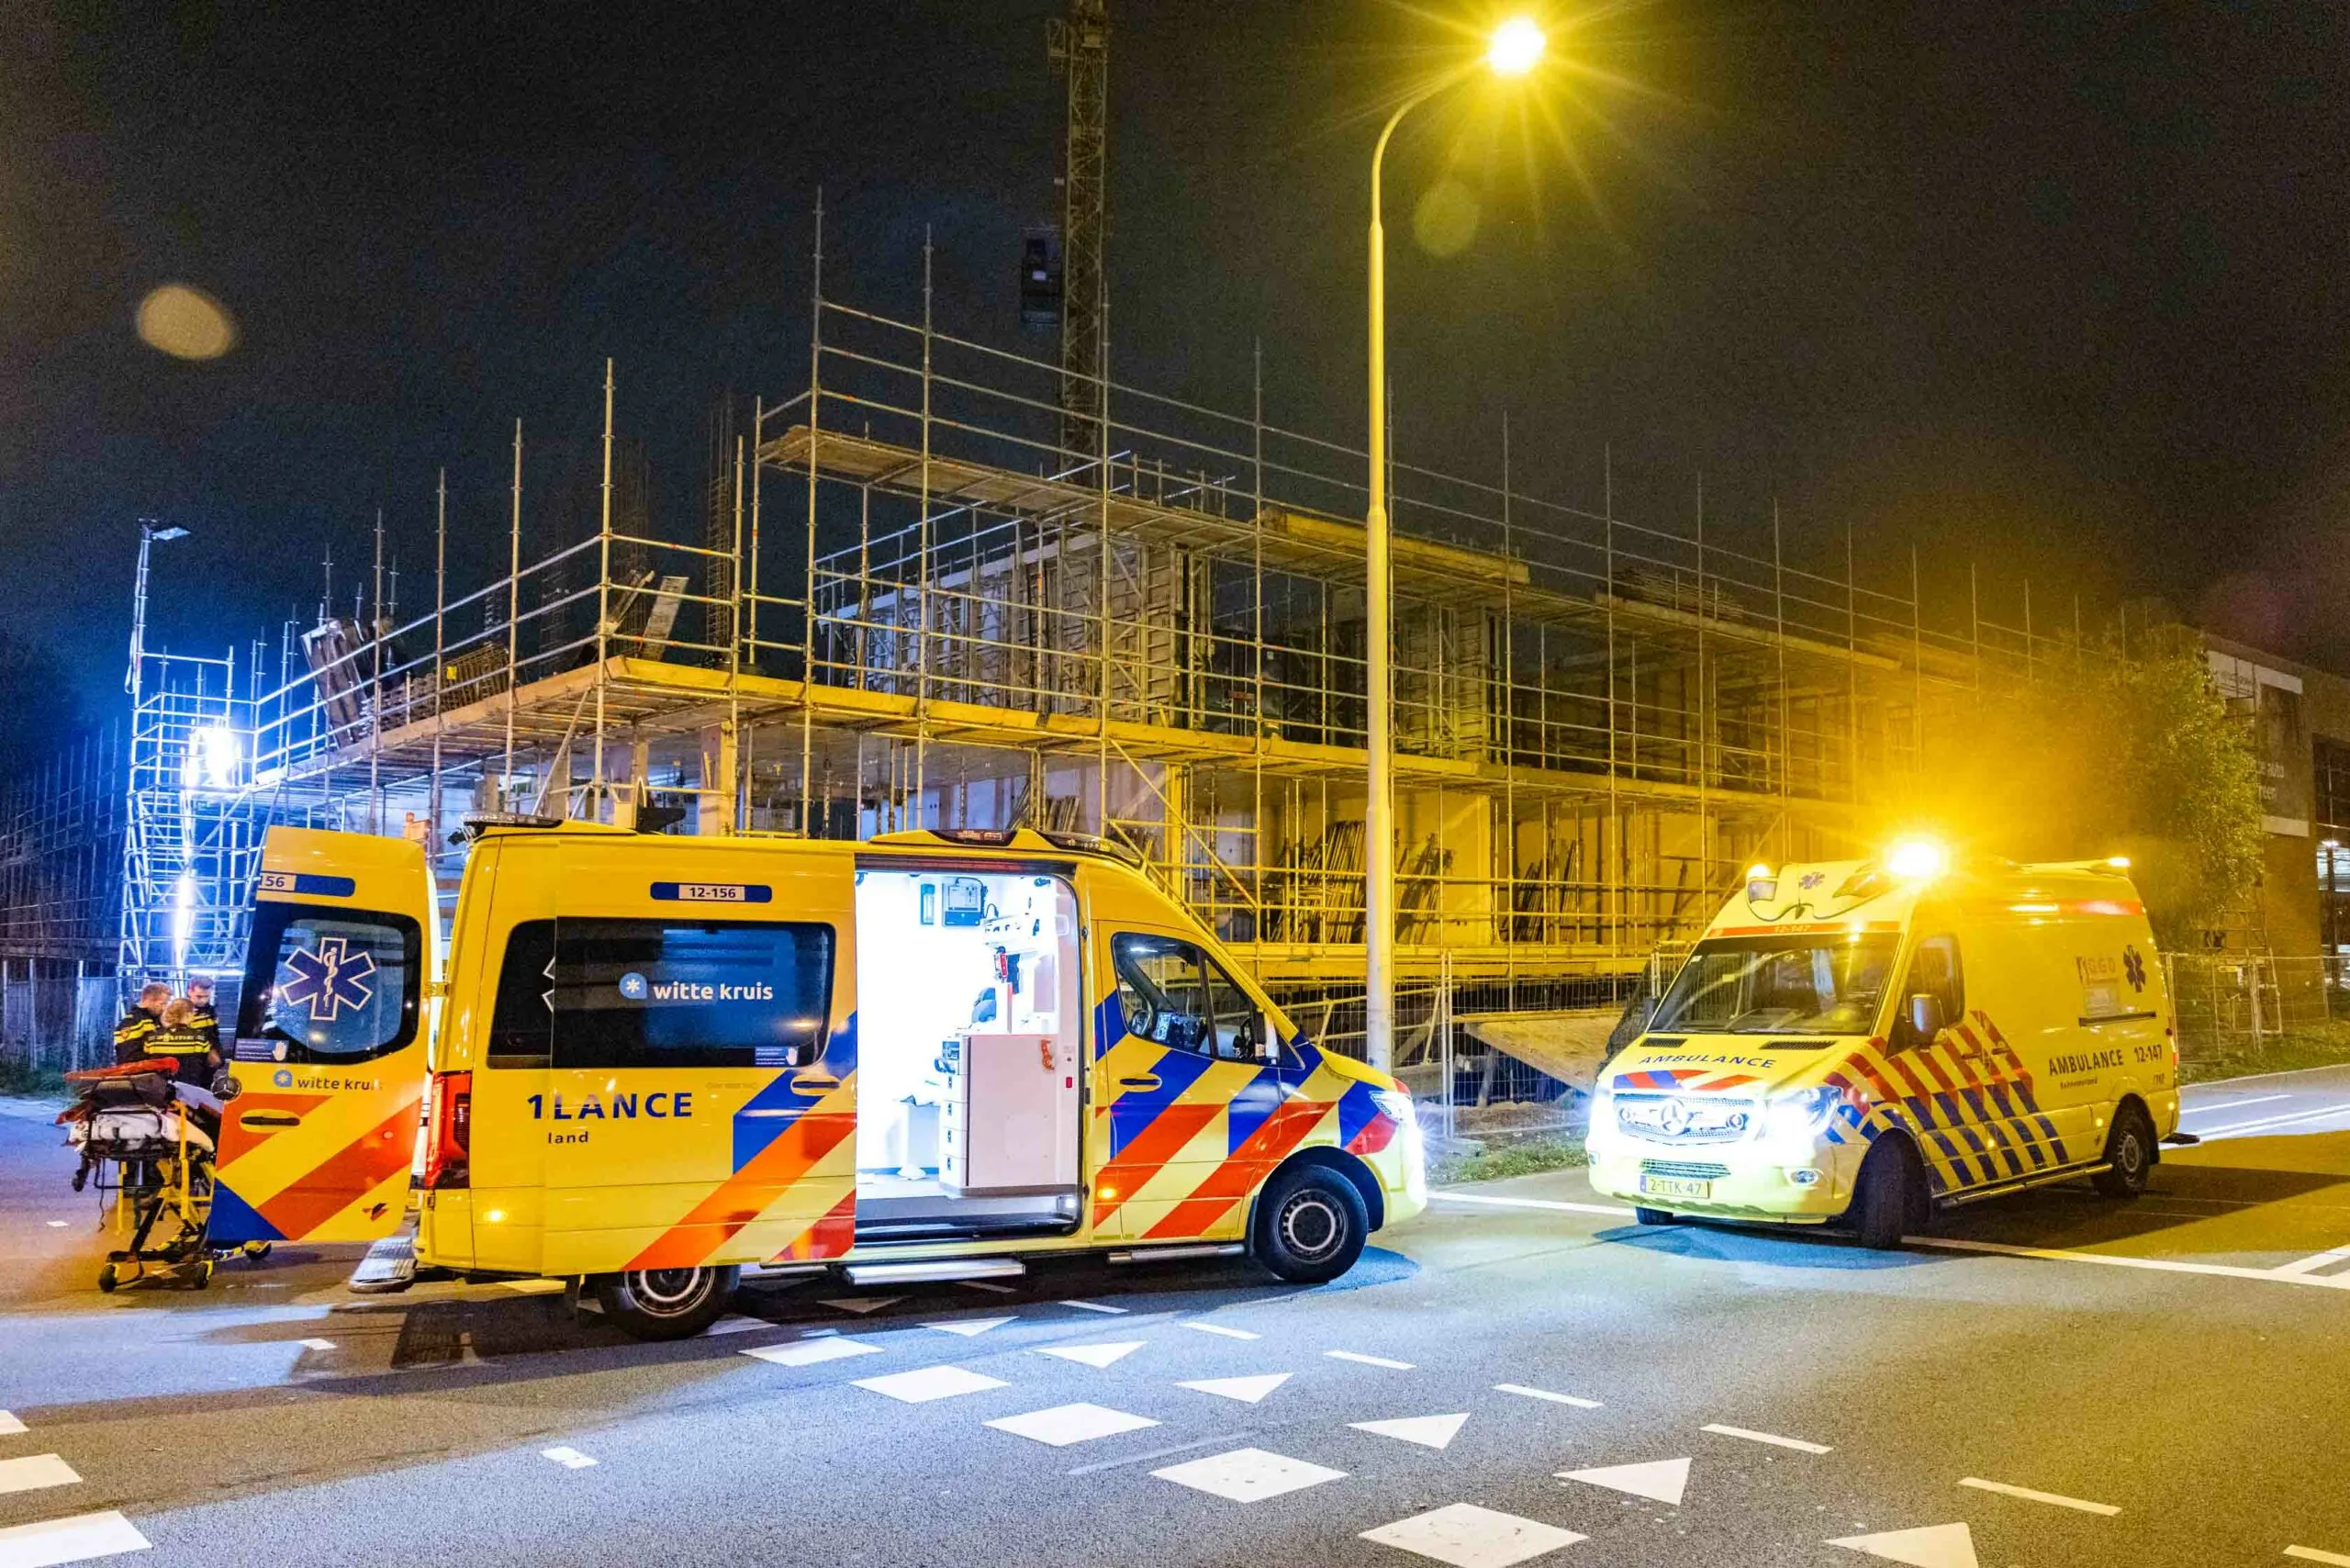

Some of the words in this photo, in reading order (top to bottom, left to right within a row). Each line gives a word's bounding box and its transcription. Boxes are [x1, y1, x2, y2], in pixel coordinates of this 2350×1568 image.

[689, 887, 736, 899] 12-156
[653, 981, 713, 1000] witte
[720, 981, 774, 1000] kruis
[1639, 1055, 1776, 1069] AMBULANCE
[2049, 1049, 2124, 1076] AMBULANCE
[2133, 1045, 2163, 1062] 12-147
[297, 1077, 341, 1090] witte
[344, 1079, 383, 1091] kru
[548, 1131, 589, 1144] land
